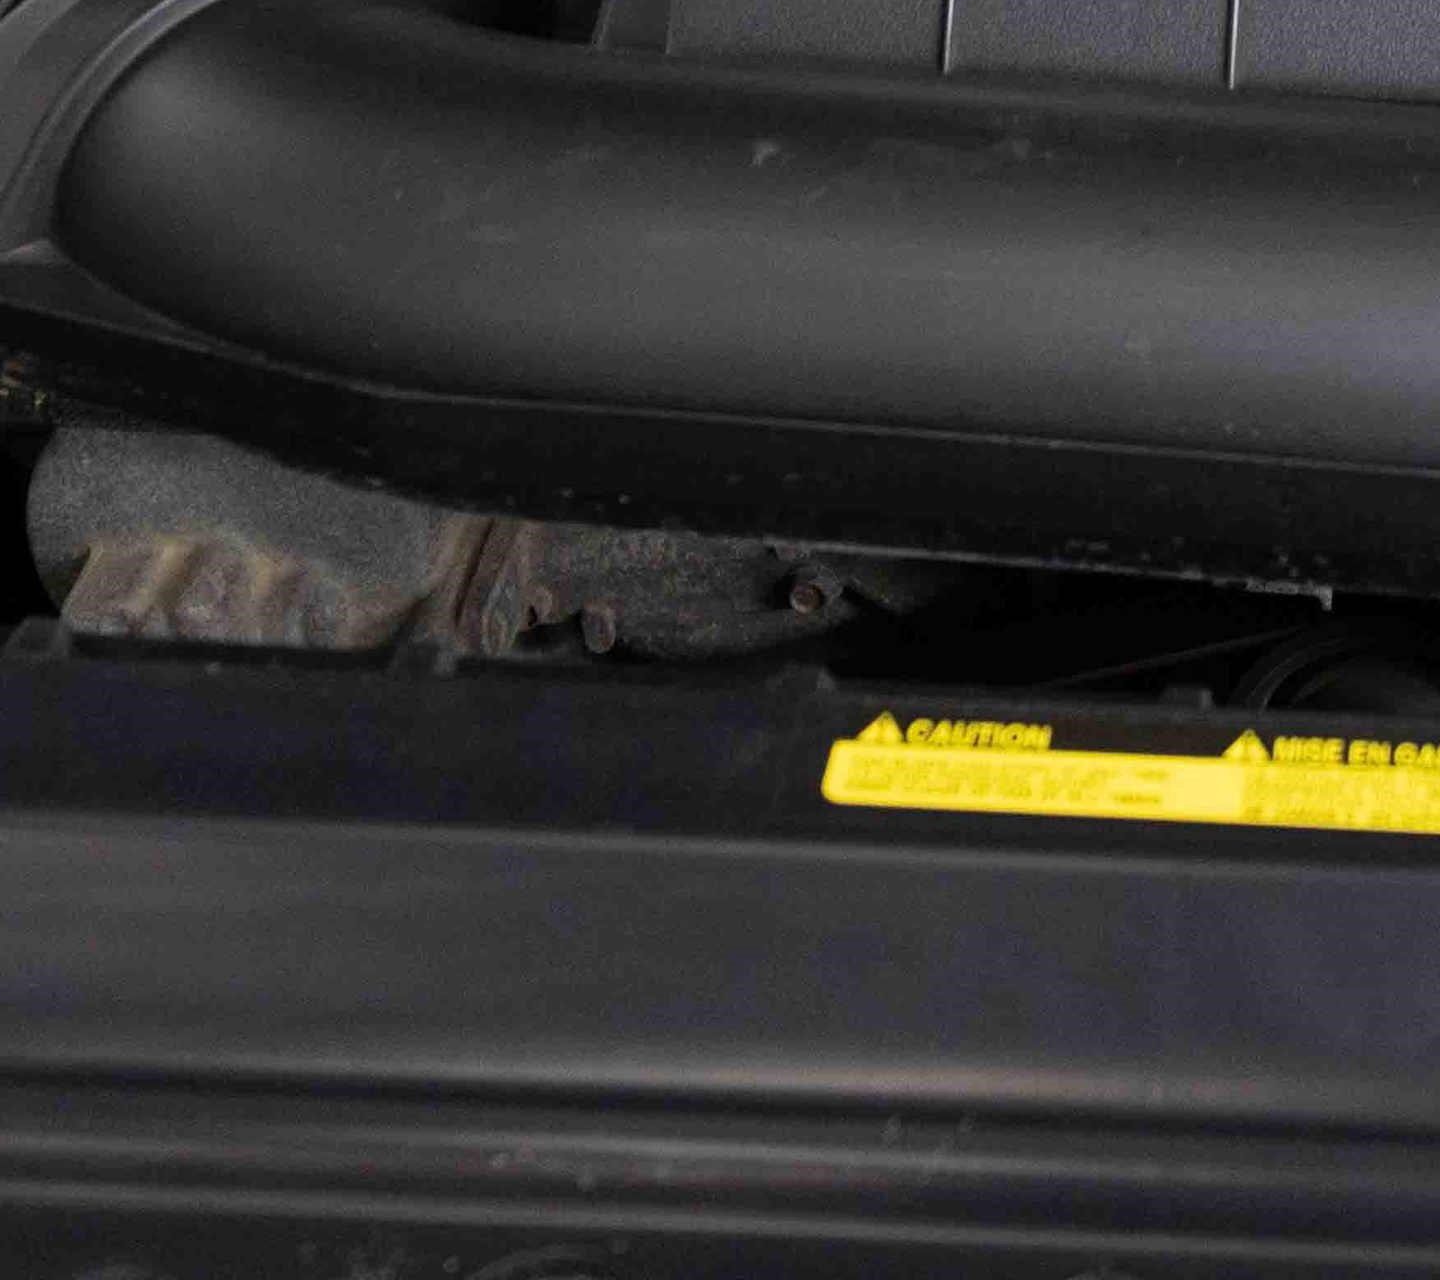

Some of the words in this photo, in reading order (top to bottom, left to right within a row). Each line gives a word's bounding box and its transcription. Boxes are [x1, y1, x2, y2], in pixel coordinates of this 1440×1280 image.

[905, 717, 1054, 750] CAUTION
[1271, 735, 1345, 765] MISE
[1348, 740, 1391, 767] EN
